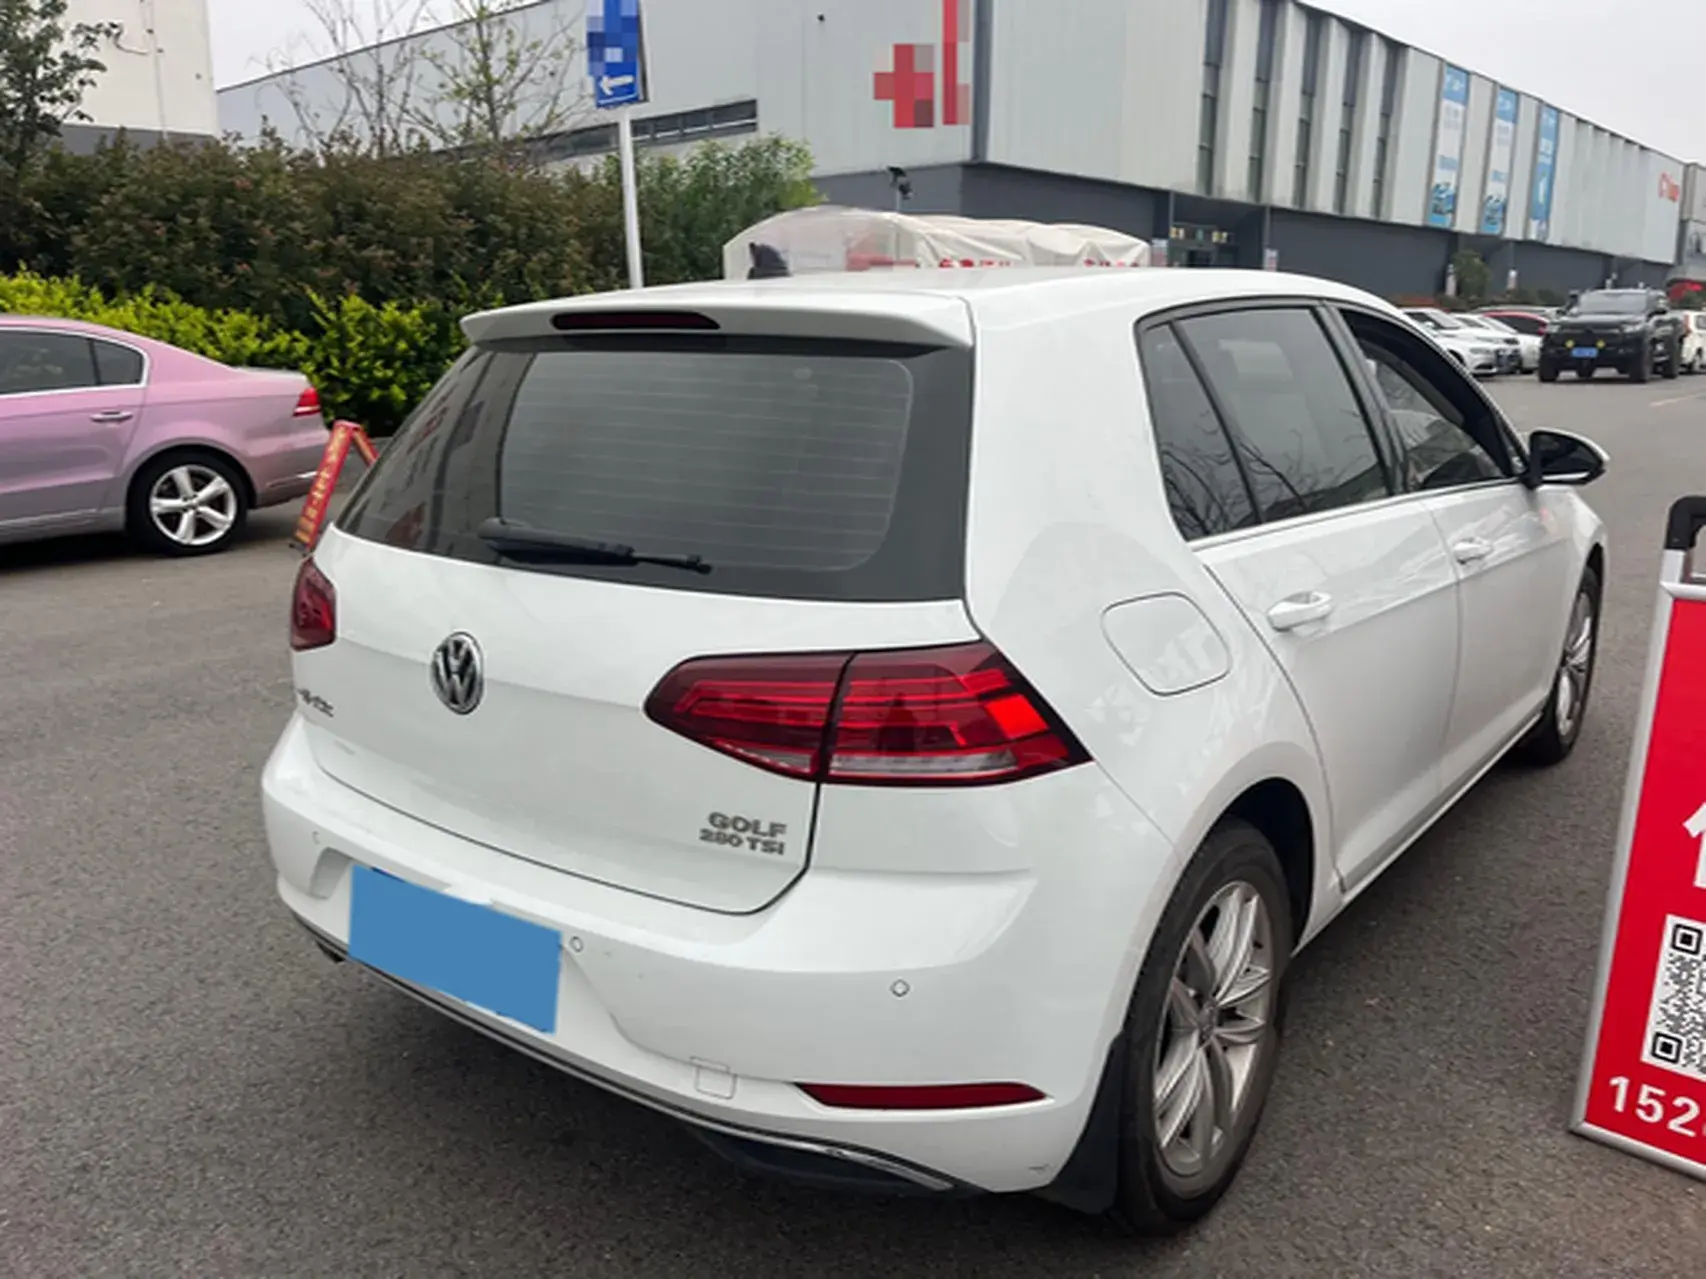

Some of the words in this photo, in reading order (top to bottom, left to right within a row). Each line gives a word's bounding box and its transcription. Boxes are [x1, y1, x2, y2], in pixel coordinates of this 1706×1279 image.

[708, 811, 787, 837] GOLF
[699, 828, 743, 847] 280
[746, 836, 785, 855] TSI
[1609, 1075, 1706, 1138] 152
